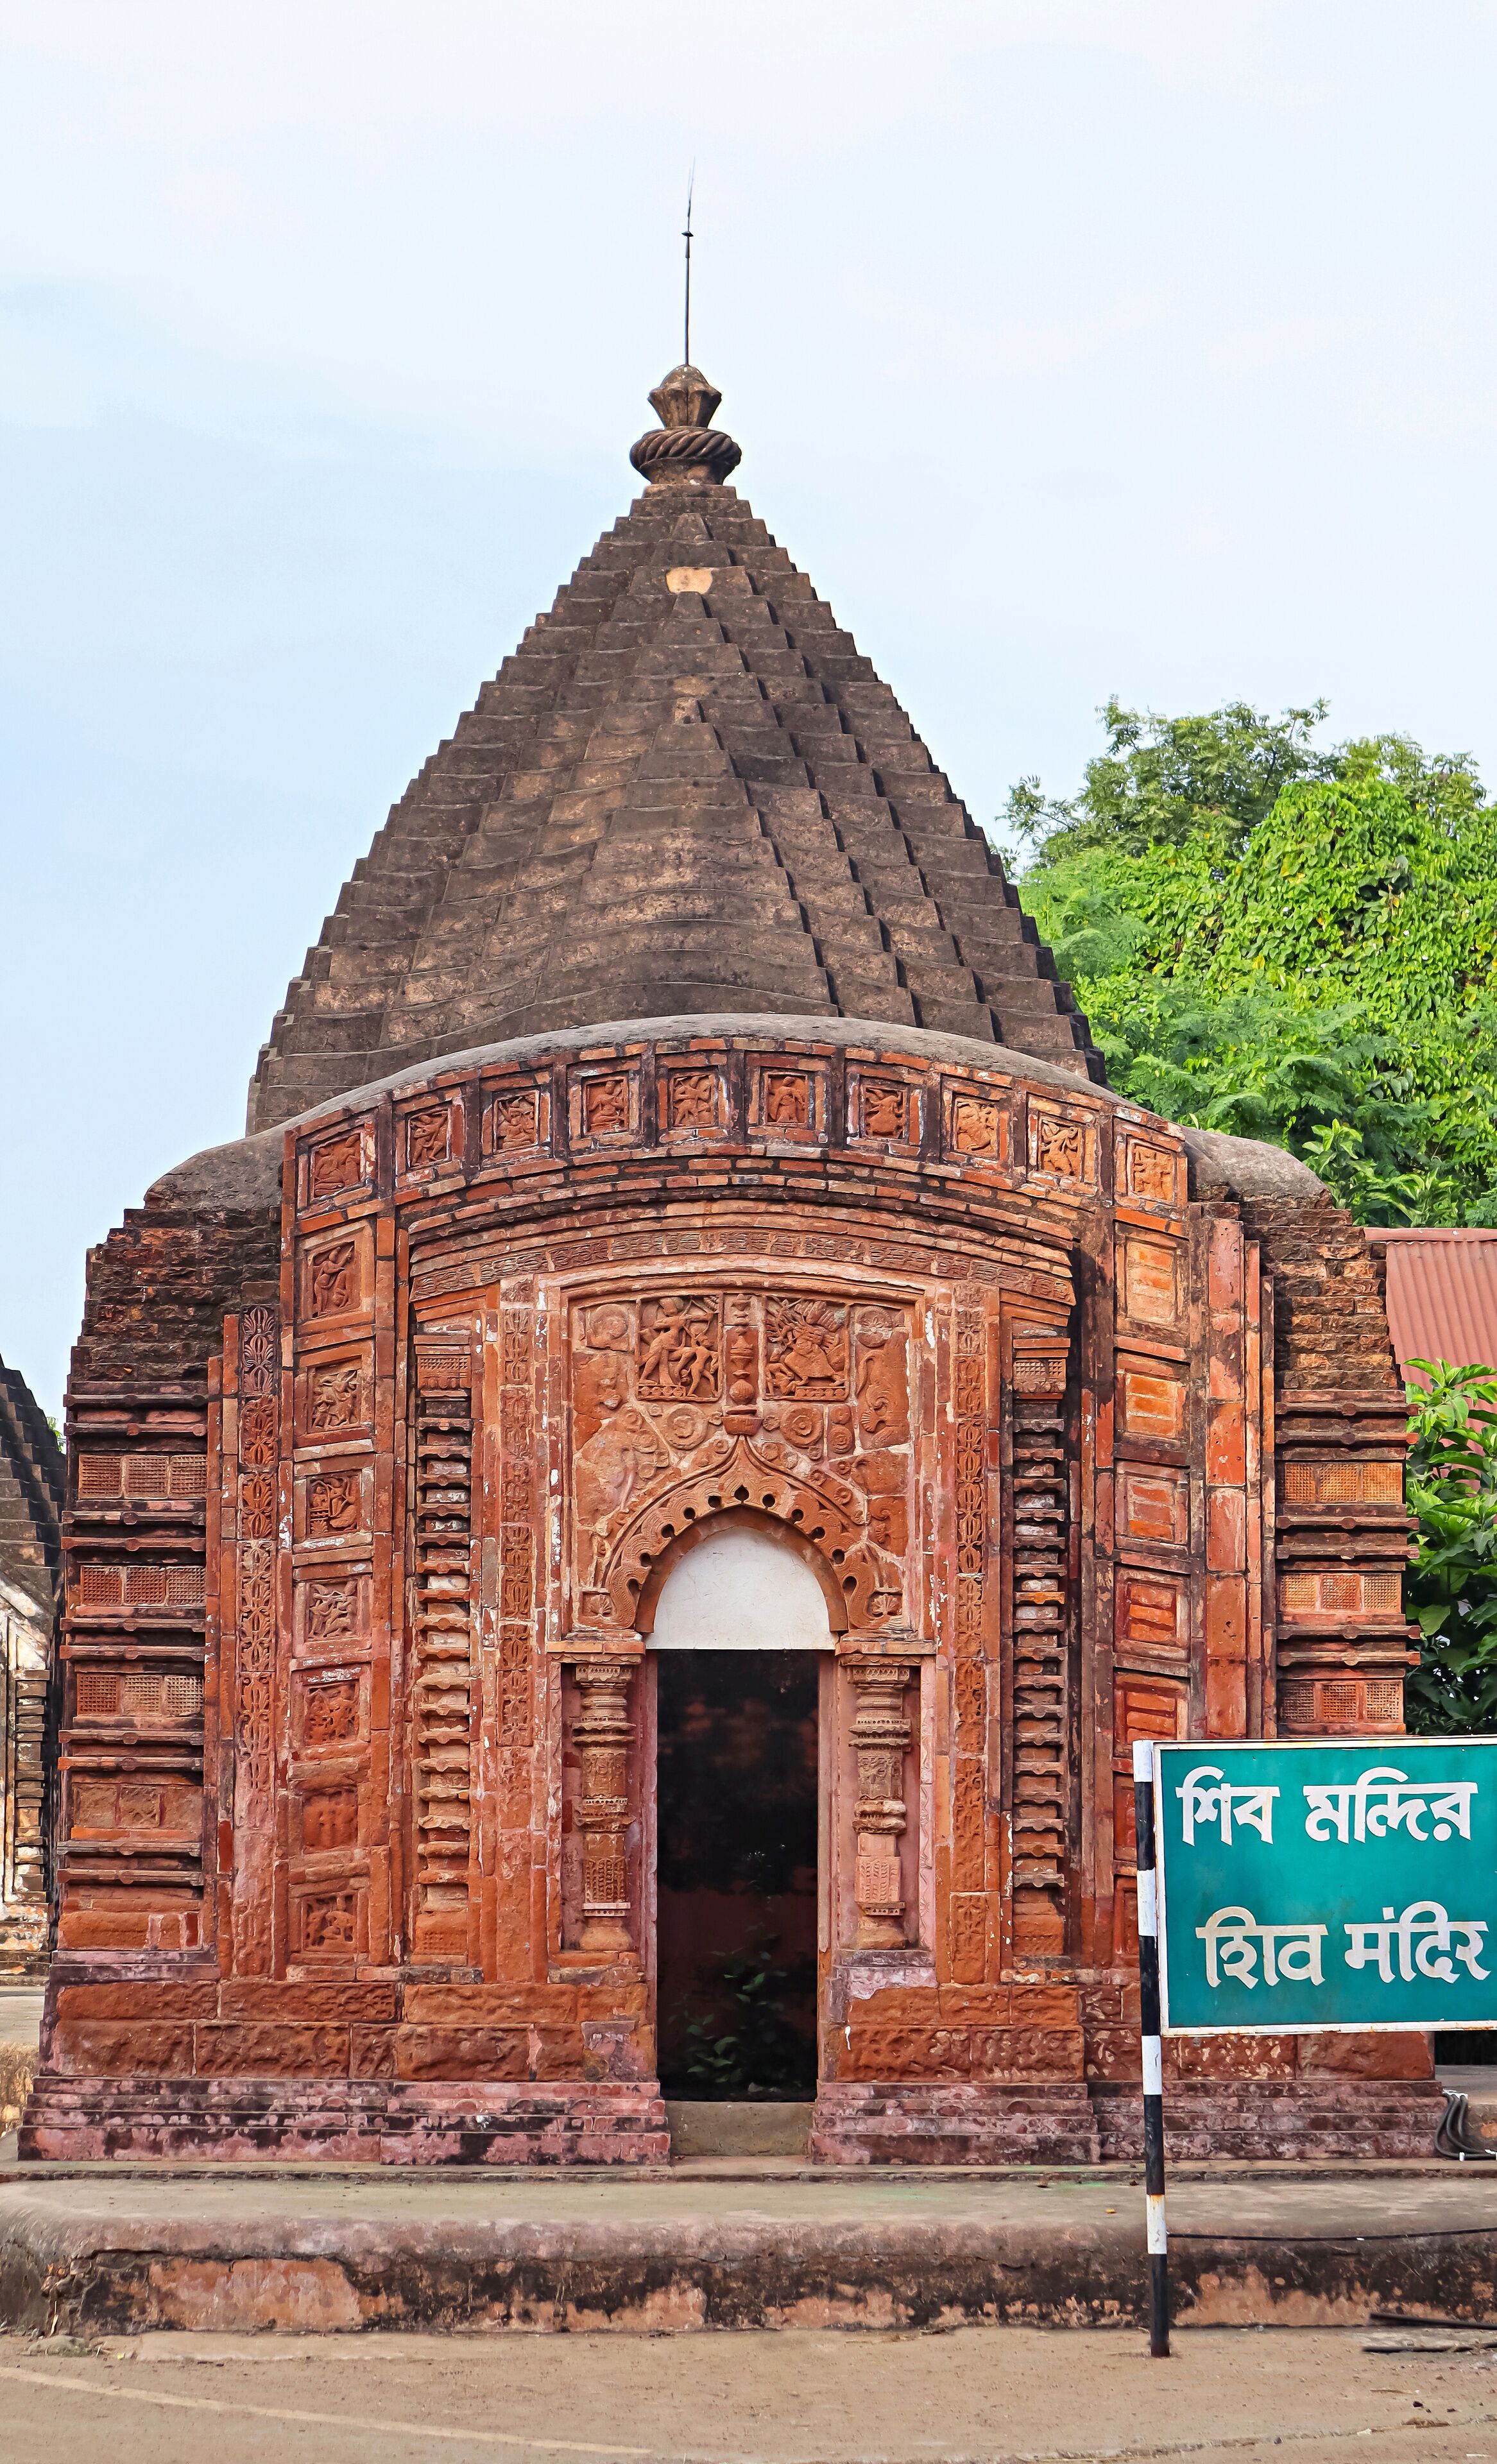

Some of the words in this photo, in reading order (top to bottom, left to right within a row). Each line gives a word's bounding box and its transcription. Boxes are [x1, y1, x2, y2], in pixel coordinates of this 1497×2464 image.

[1175, 1766, 1281, 1846] শিব
[1303, 1767, 1478, 1844] মন্দির
[1195, 1906, 1328, 1989] शिव
[1344, 1901, 1491, 1983] मंदिर
